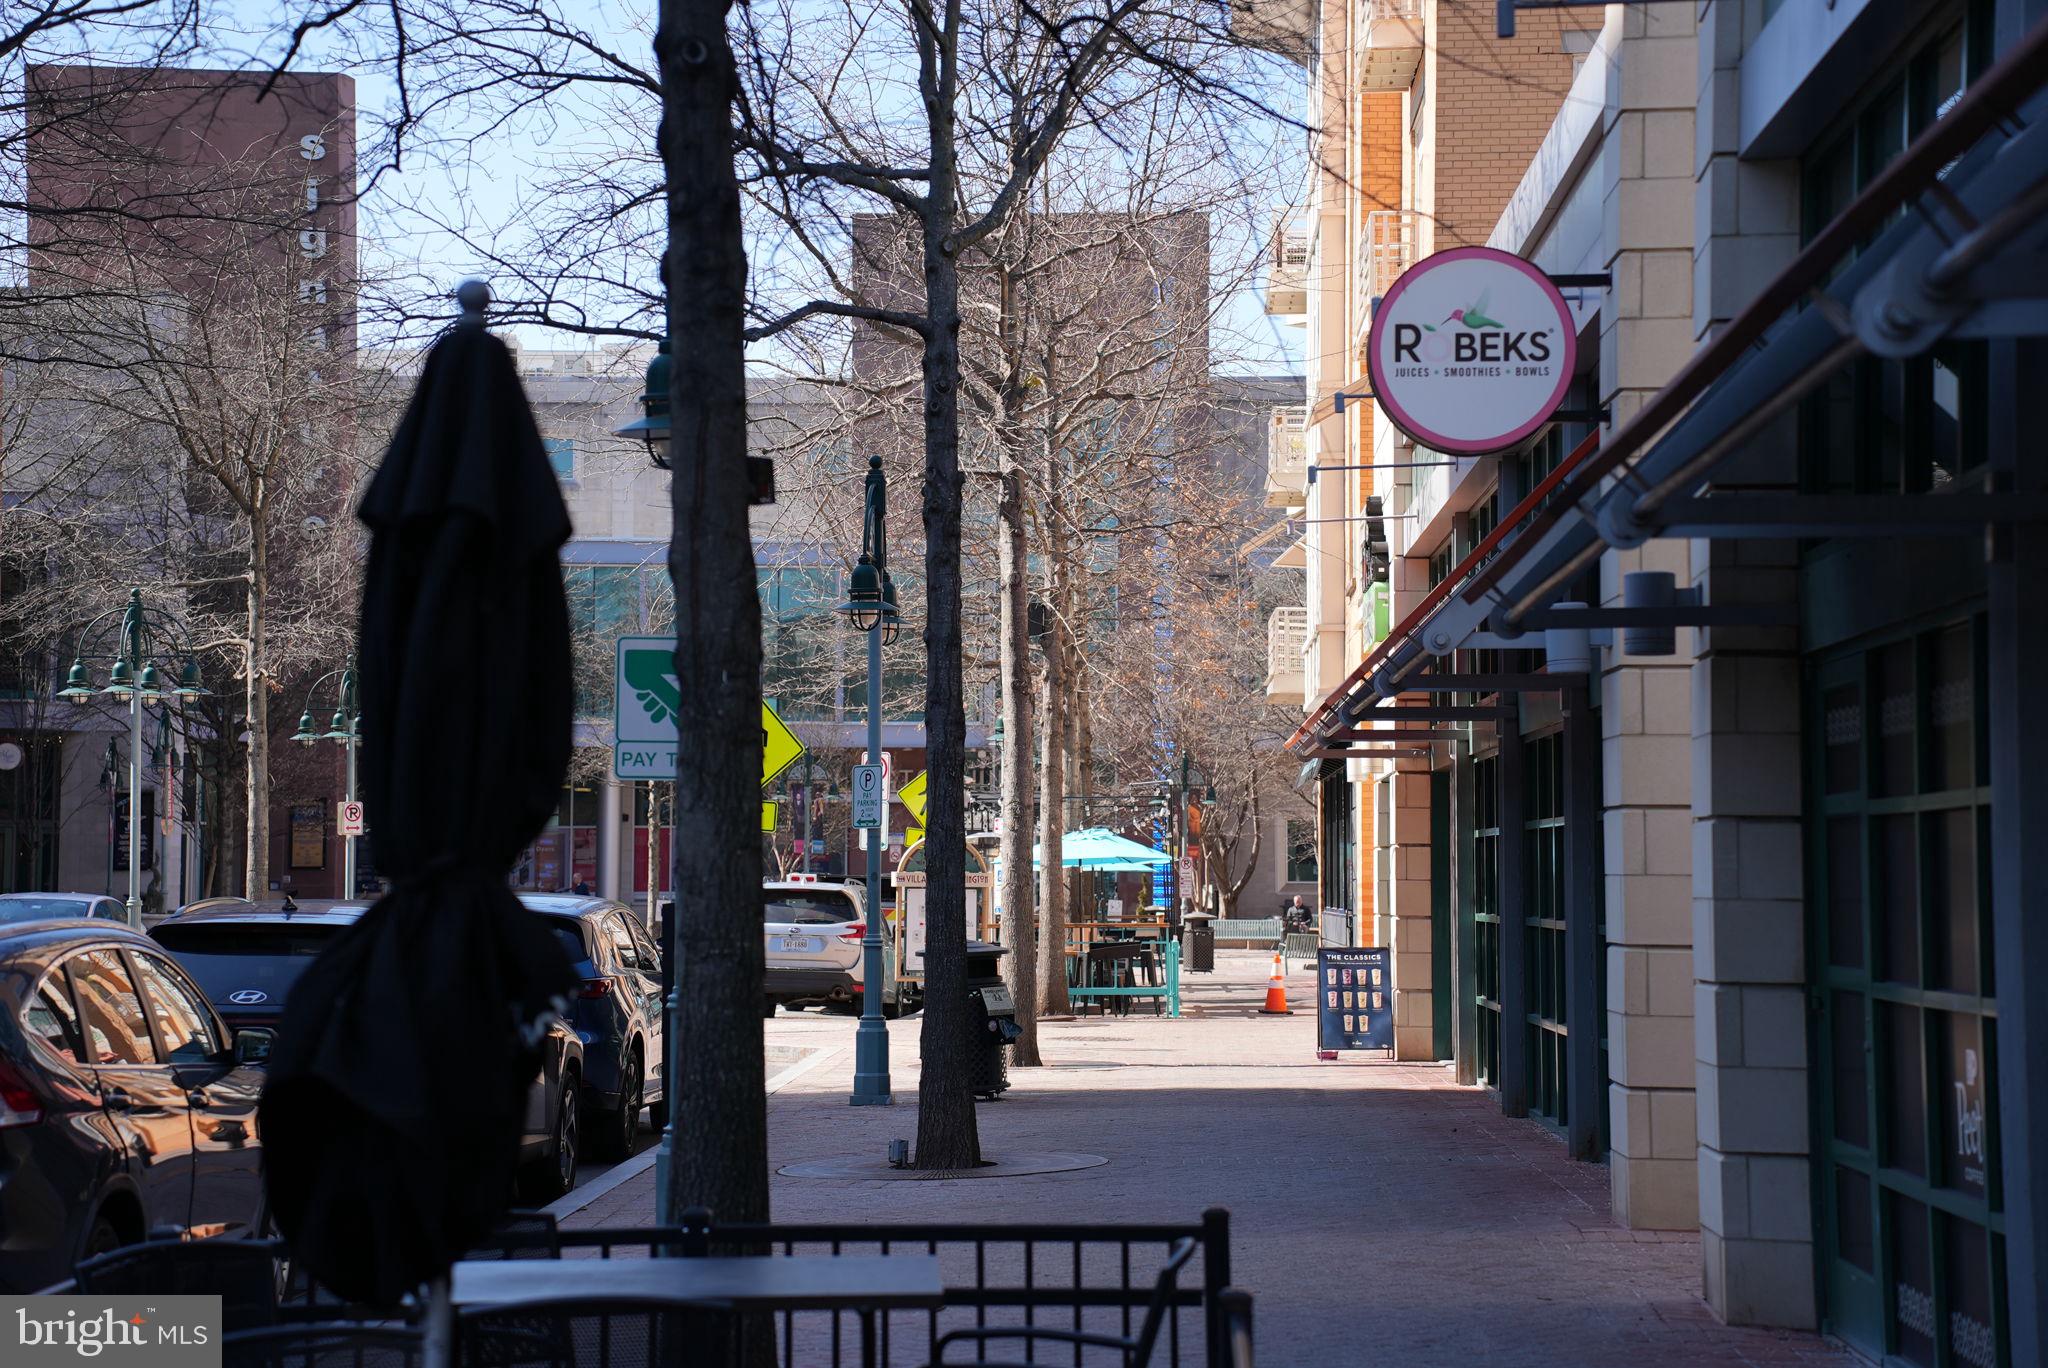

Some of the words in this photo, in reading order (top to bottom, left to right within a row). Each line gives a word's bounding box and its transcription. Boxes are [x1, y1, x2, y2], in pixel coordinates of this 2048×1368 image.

[1395, 367, 1430, 378] JUICES
[1443, 366, 1501, 377] SMOOTHIES
[1515, 366, 1550, 376] BOWLS
[621, 752, 657, 767] PAY
[666, 752, 679, 767] T
[857, 799, 878, 807] PARKING
[906, 873, 926, 883] VILLA
[966, 875, 989, 883] INGTON
[1955, 1082, 1983, 1163] Peet
